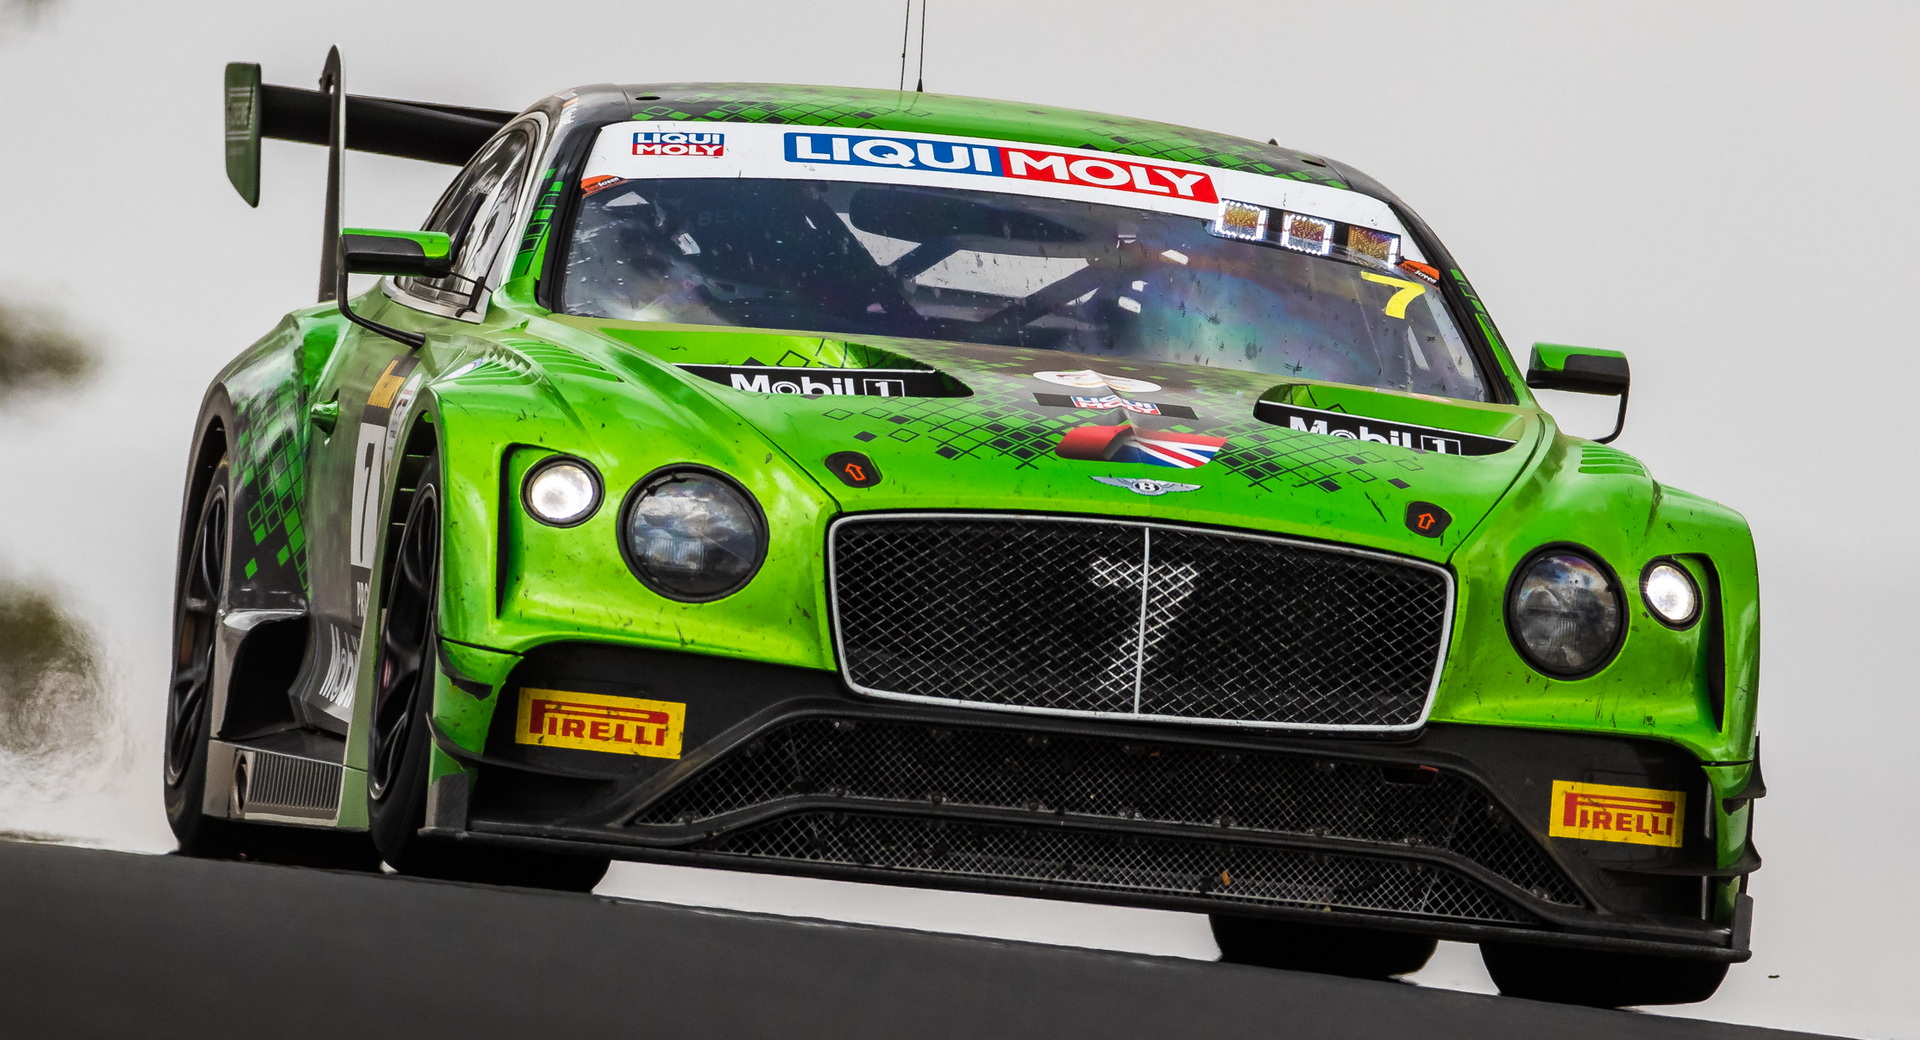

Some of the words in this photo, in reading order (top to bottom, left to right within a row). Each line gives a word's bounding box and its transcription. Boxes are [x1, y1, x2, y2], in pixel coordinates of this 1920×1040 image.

[636, 144, 722, 155] MOLY
[637, 133, 720, 144] LIQUI
[795, 135, 993, 172] LIQUI
[1008, 151, 1205, 197] MOLY
[1360, 270, 1426, 319] 7
[730, 373, 855, 395] Mobil
[1091, 556, 1200, 694] 7
[529, 698, 670, 747] PIRELLI
[1563, 792, 1676, 836] PIRELLI
